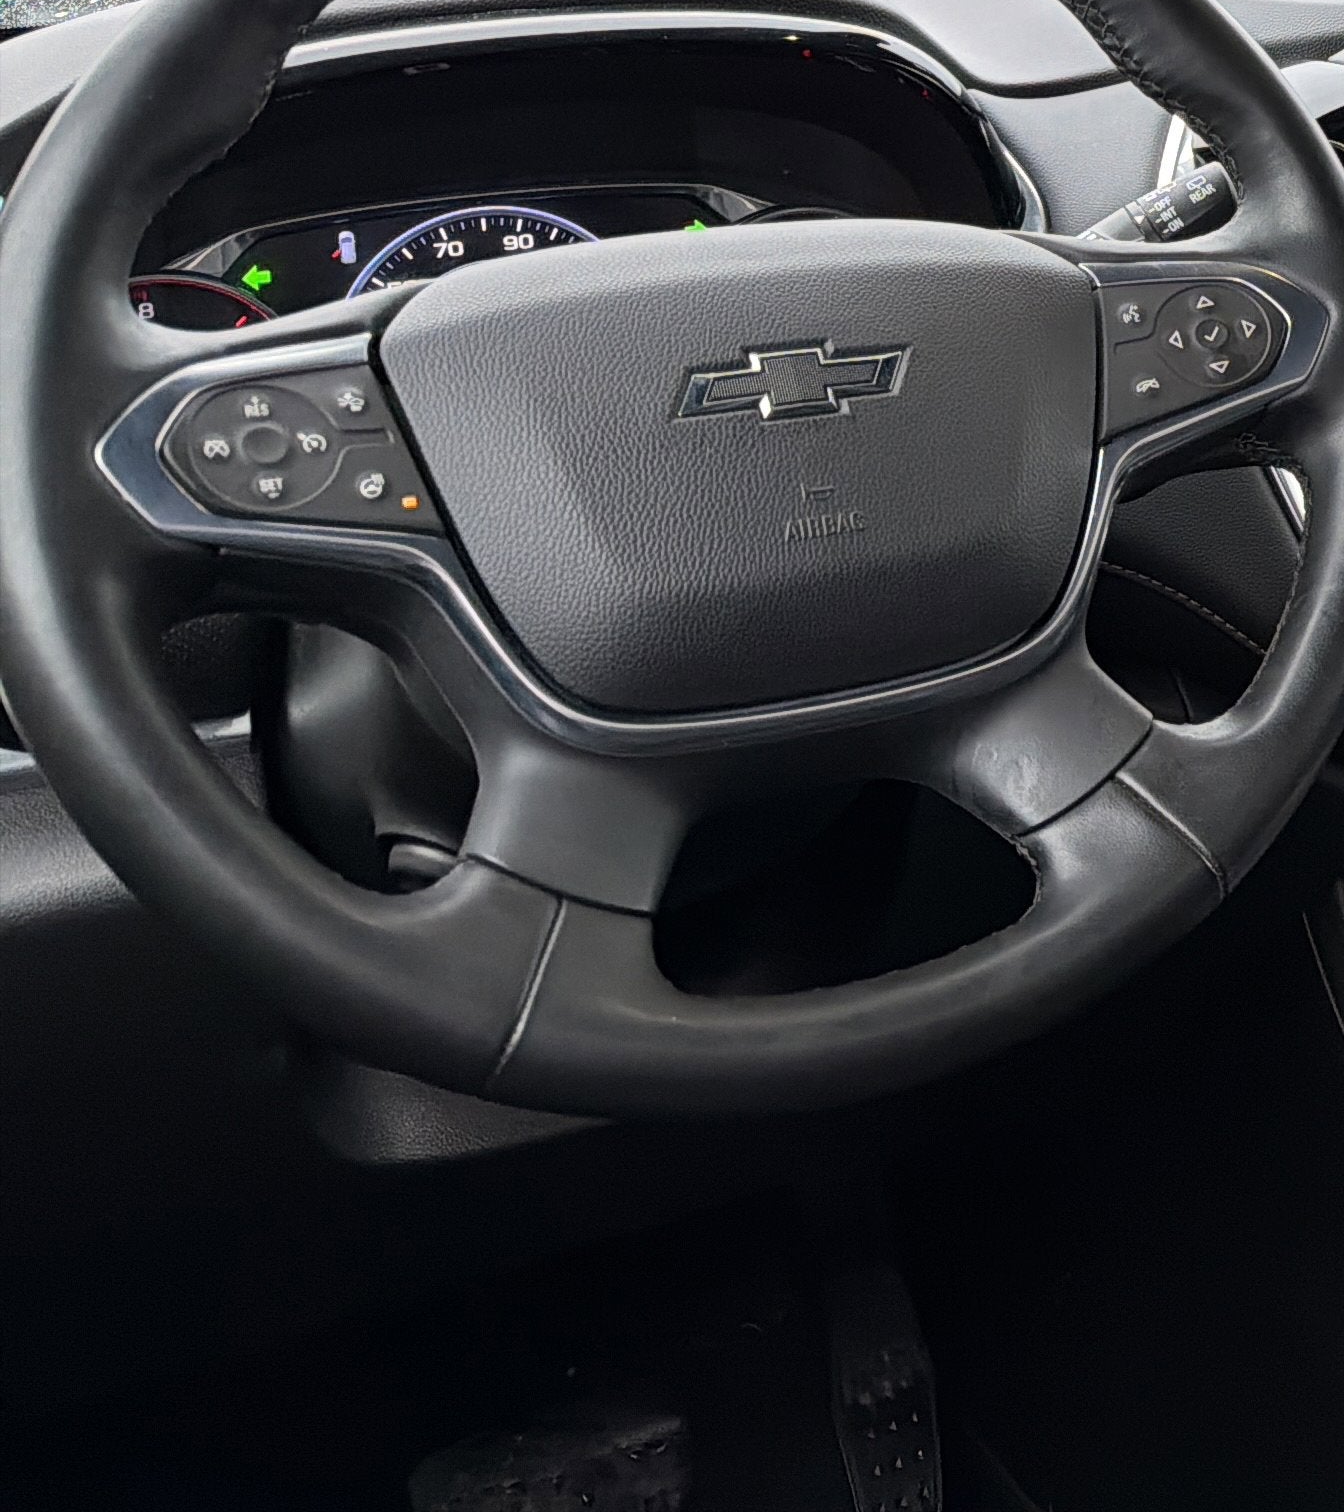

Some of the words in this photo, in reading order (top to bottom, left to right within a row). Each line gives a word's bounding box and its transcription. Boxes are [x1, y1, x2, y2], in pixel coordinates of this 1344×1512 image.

[1189, 183, 1216, 204] REAR
[1153, 196, 1172, 212] OFF
[1160, 206, 1179, 223] INT
[1167, 217, 1185, 233] ON
[433, 240, 465, 259] 70
[502, 233, 535, 251] 90
[138, 302, 155, 320] 8
